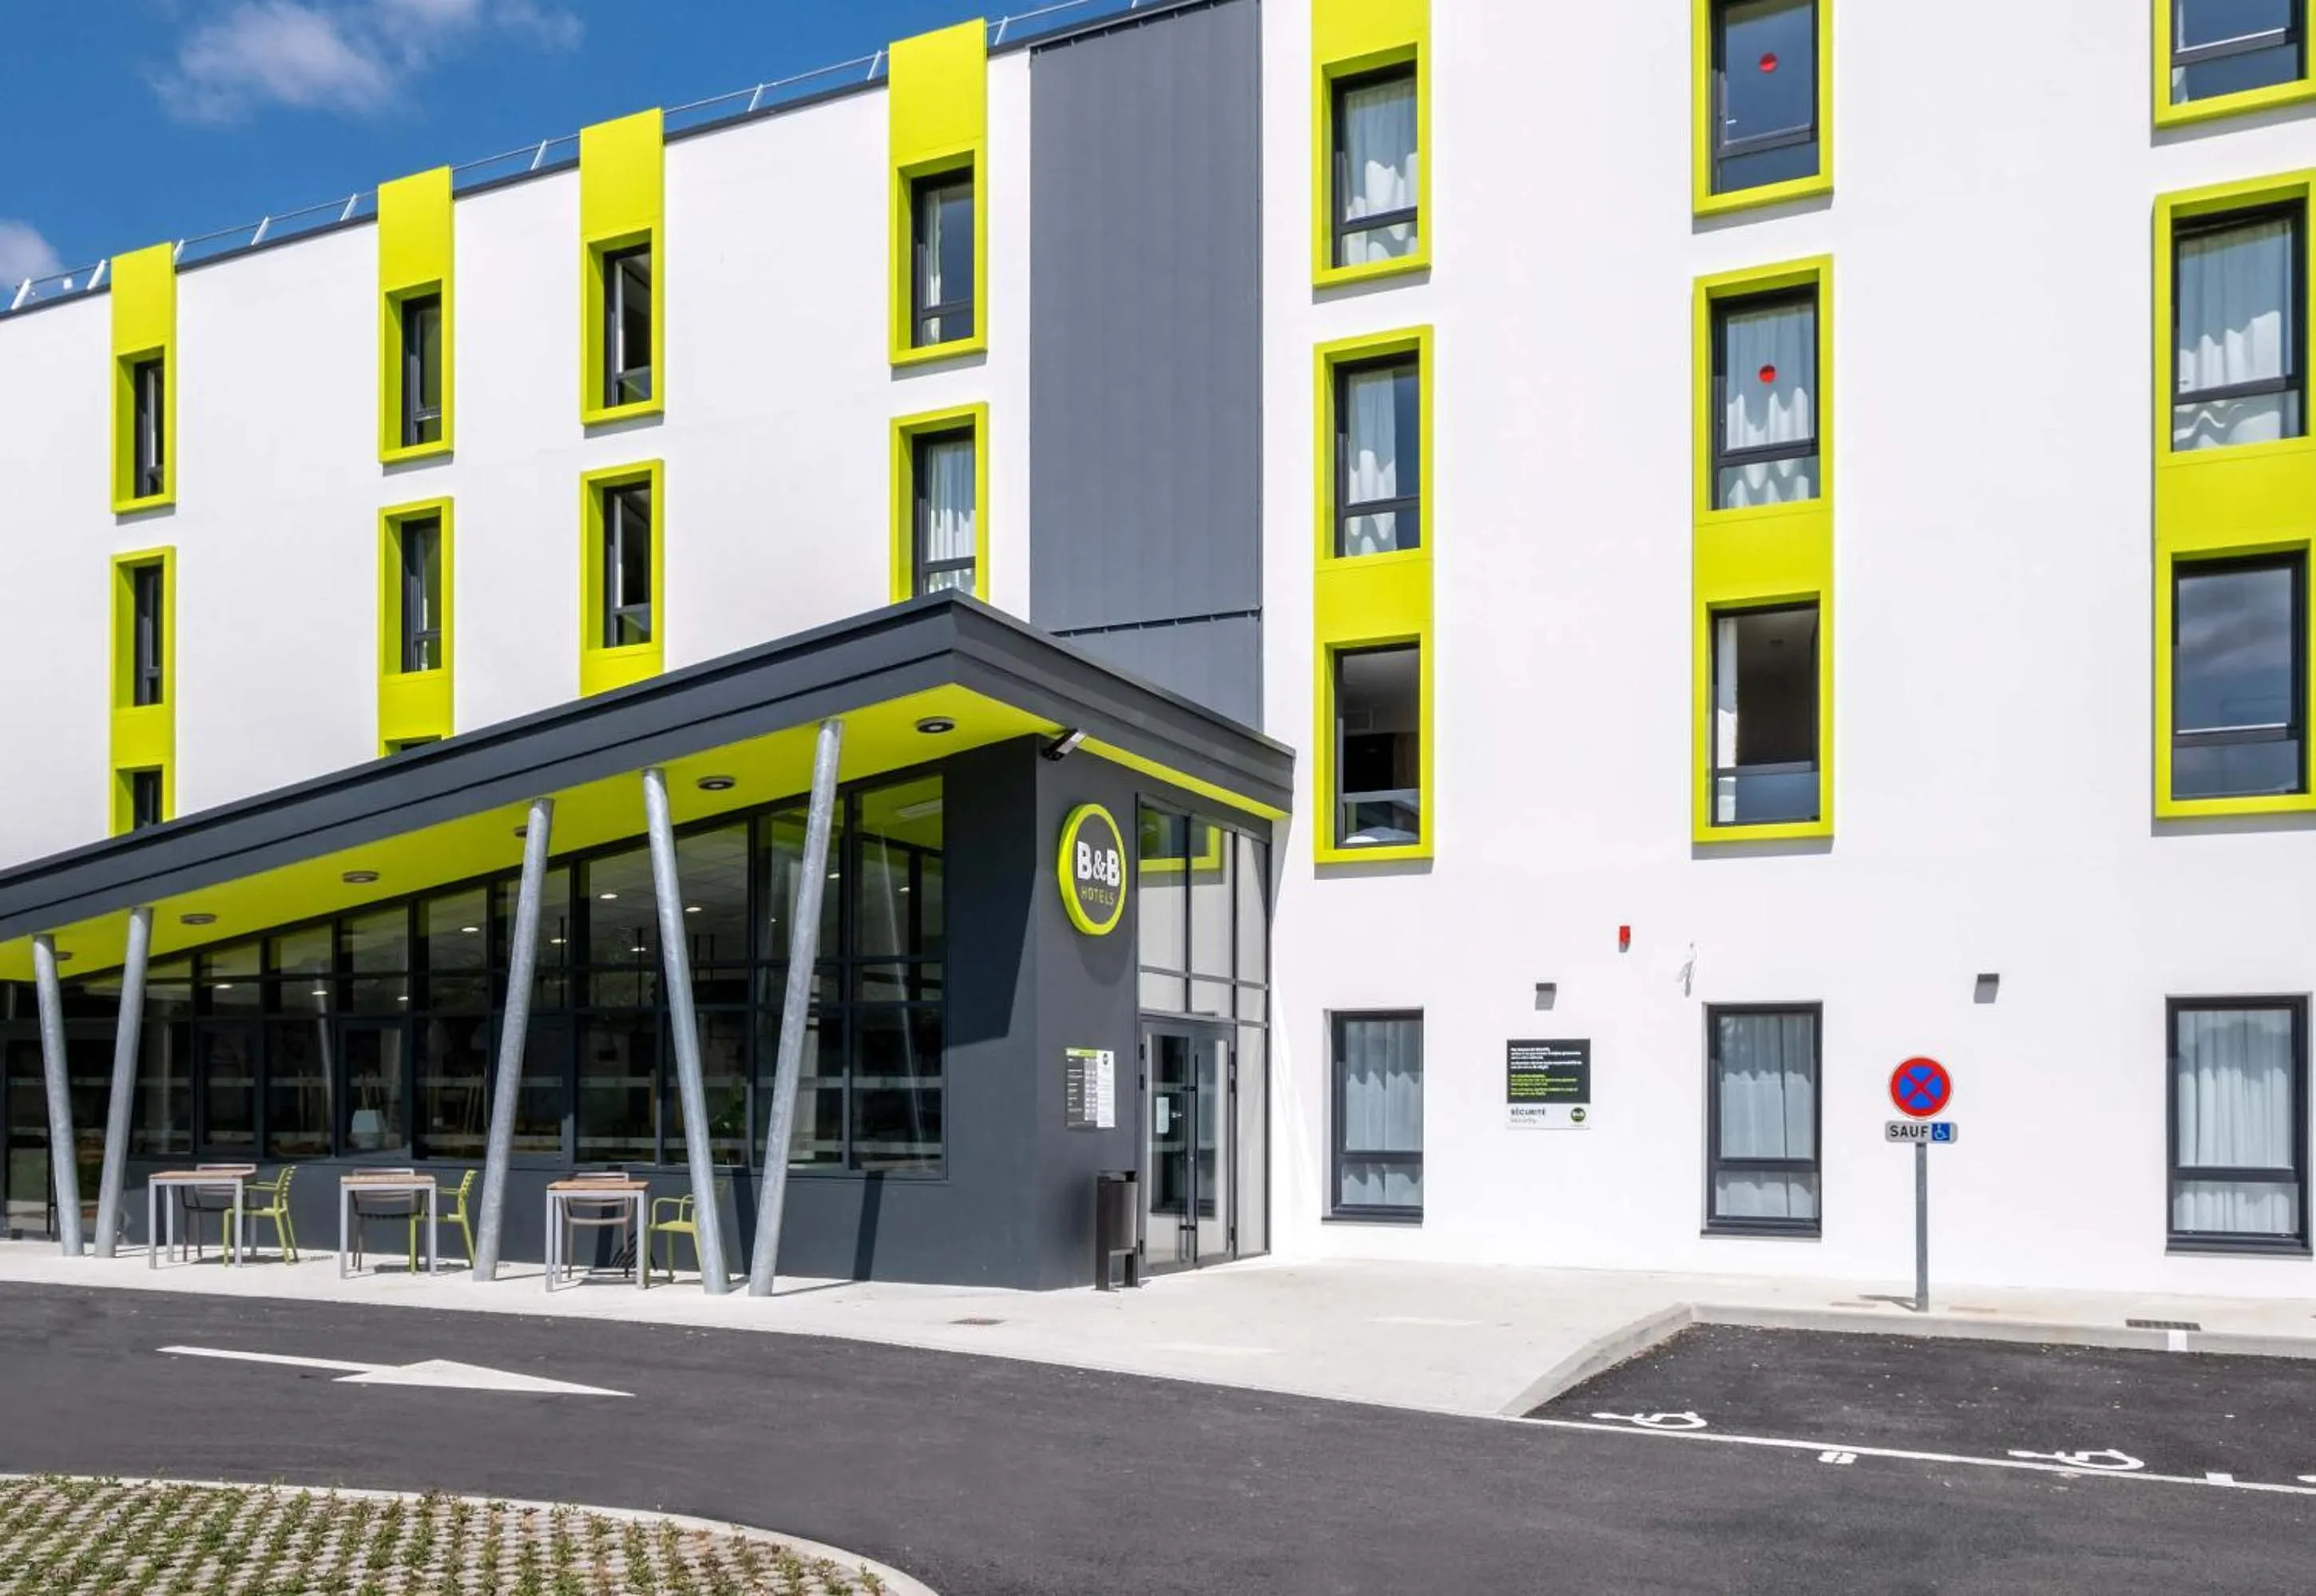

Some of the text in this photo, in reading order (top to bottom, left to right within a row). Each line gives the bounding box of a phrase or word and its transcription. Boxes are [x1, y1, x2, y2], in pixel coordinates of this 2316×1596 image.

[1077, 841, 1120, 886] B&B
[1081, 885, 1114, 905] HOTELS
[1890, 1124, 1929, 1137] SAUF
